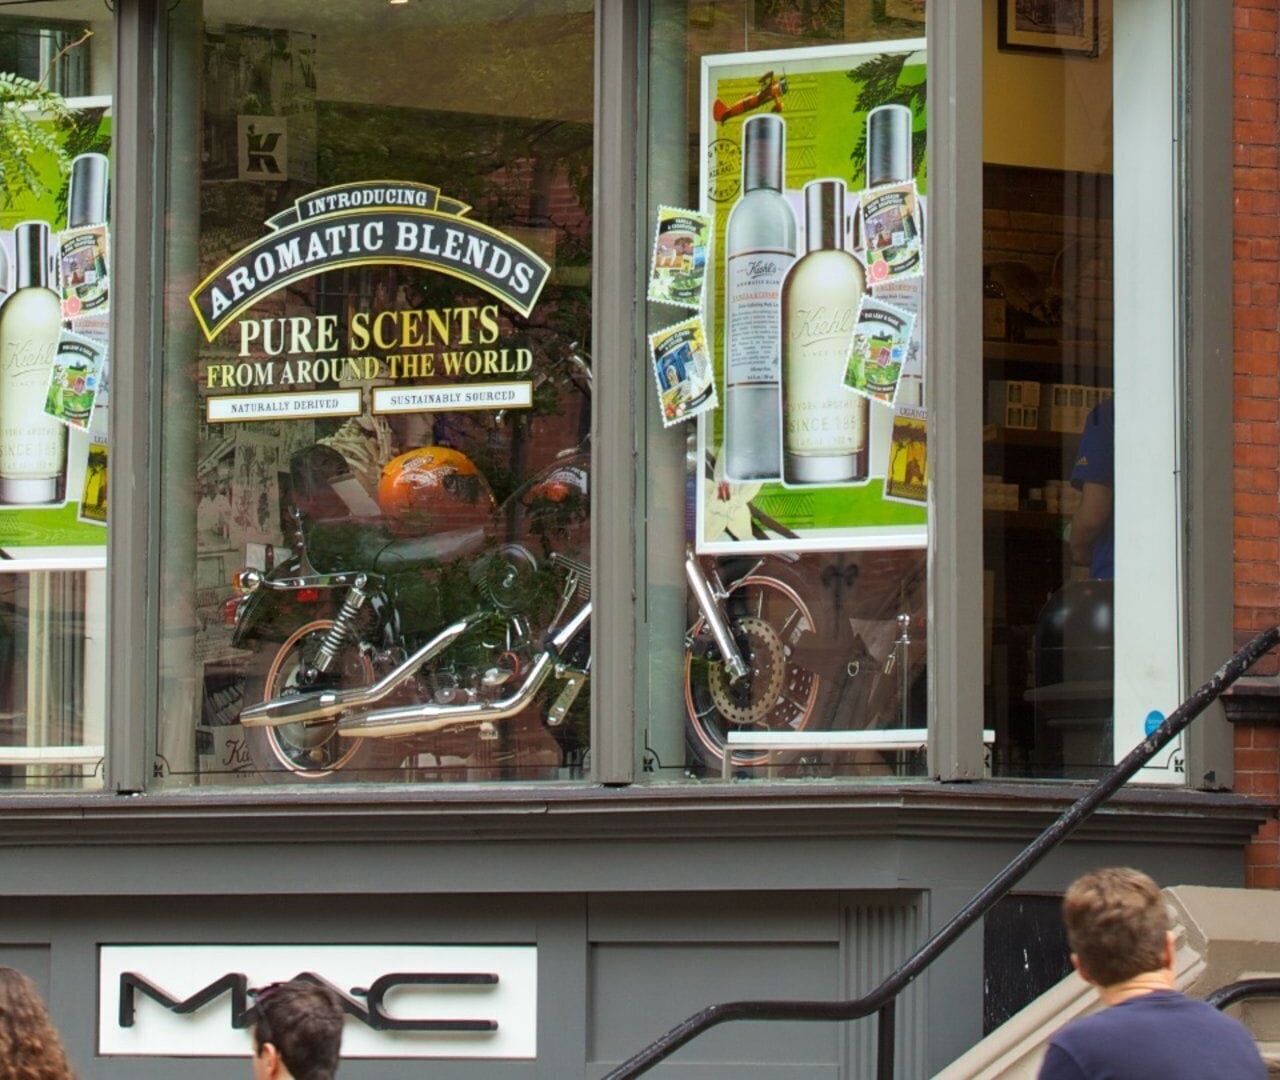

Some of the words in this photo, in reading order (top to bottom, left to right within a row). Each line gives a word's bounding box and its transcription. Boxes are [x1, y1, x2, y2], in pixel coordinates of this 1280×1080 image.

[307, 188, 428, 217] INTRODUCING
[210, 221, 384, 319] AROMATIC
[395, 220, 536, 295] BLENDS
[238, 314, 338, 358] PURE
[350, 305, 500, 351] SCENTS
[792, 306, 852, 341] Kiehl
[206, 361, 275, 389] FROM
[279, 355, 380, 385] AROUND
[386, 352, 436, 379] THE
[442, 348, 533, 376] WORLD
[231, 401, 290, 414] NATURALLY
[293, 398, 339, 412] DERIVED
[390, 392, 461, 406] SUSTAINABLY
[465, 390, 516, 403] SOURCED
